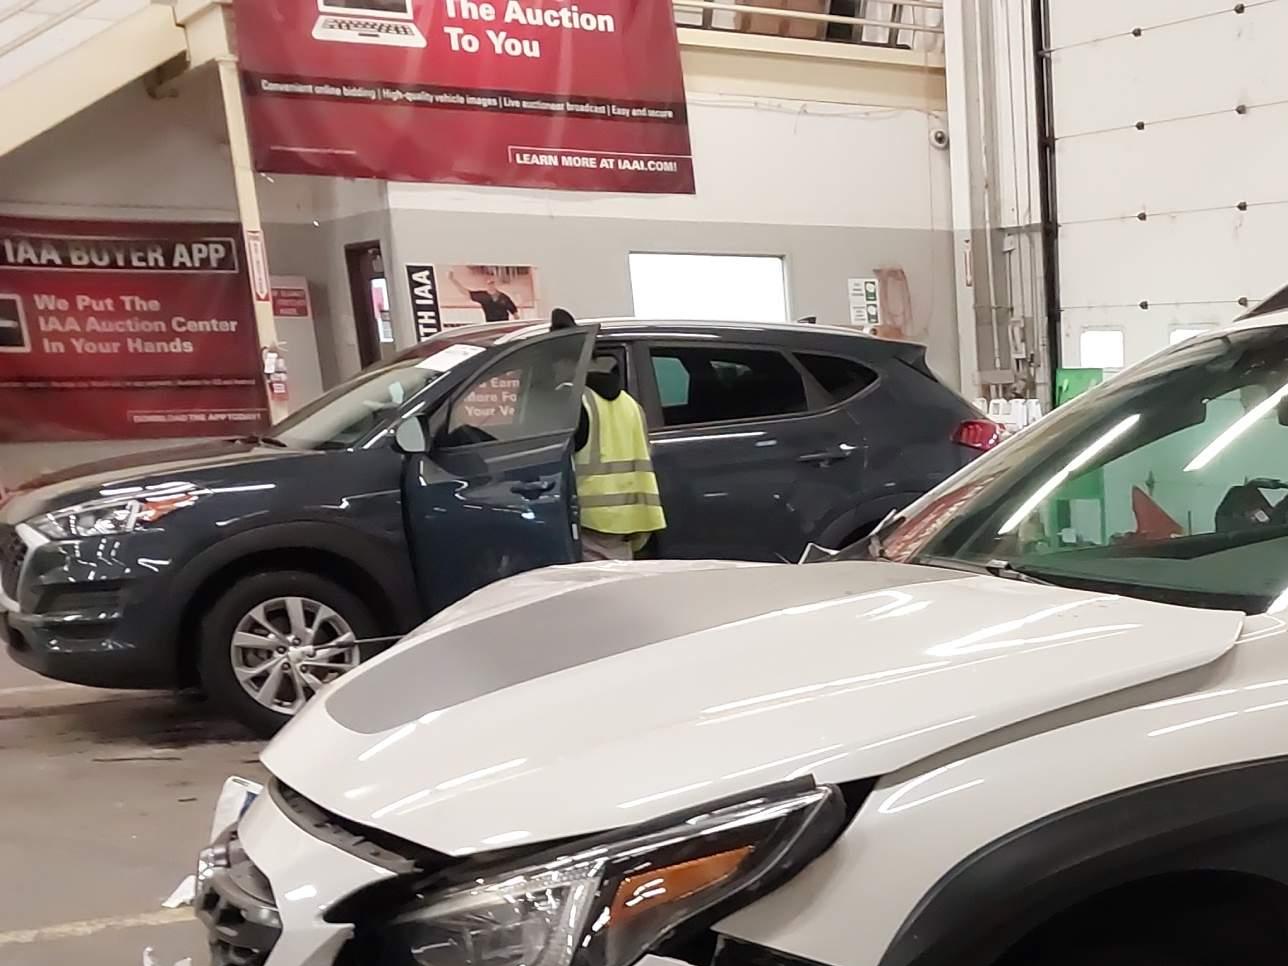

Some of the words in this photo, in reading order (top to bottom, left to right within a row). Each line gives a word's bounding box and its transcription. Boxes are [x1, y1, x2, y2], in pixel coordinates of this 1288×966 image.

[445, 0, 496, 21] The
[504, 0, 615, 33] Auction
[443, 26, 480, 53] To
[486, 29, 541, 58] You
[315, 84, 342, 96] online
[342, 86, 377, 100] bidding
[435, 93, 465, 105] vehicle
[466, 94, 498, 108] images
[503, 96, 521, 108] Live
[566, 101, 606, 114] broadcast
[611, 105, 630, 118] Easy
[632, 107, 647, 117] and
[516, 153, 559, 166] LEARN
[561, 155, 597, 168] MORE
[600, 158, 616, 170] AT
[618, 159, 677, 173] IAAI.COM!
[3, 238, 63, 265] IAA
[69, 240, 166, 267] BUYER
[172, 243, 226, 268] APP
[411, 269, 435, 305] IAA
[33, 294, 69, 311] We
[76, 295, 115, 312] Put
[120, 295, 161, 312] The
[38, 315, 81, 333] IAA
[86, 316, 167, 333] Auction
[171, 316, 239, 333] Center
[416, 311, 438, 343] TH
[43, 337, 66, 353] In
[70, 337, 121, 354] Your
[127, 337, 194, 353] Hands
[465, 405, 496, 417] Your
